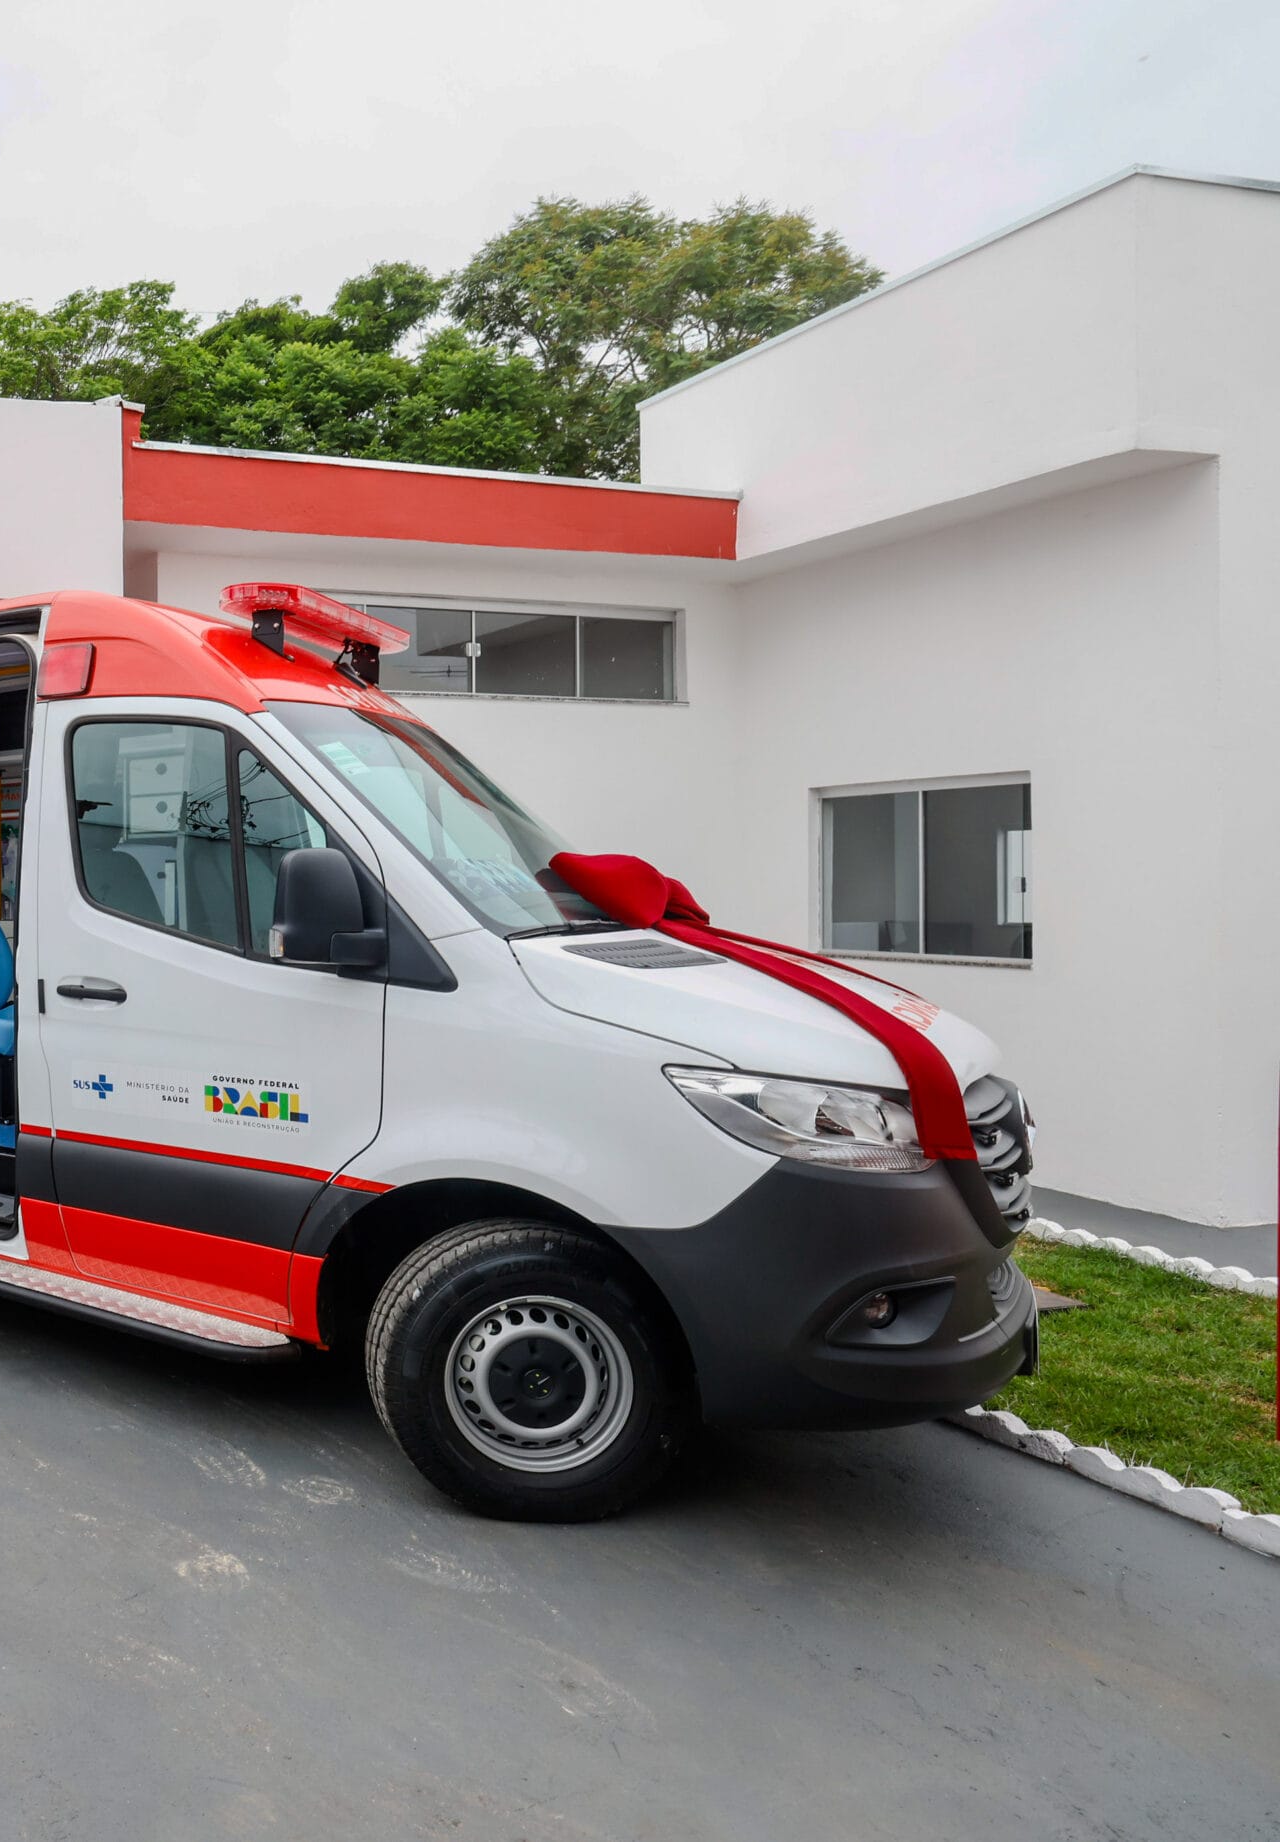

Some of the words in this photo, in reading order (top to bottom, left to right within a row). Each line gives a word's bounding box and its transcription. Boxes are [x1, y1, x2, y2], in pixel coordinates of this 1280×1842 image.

[73, 1080, 91, 1090] SUS
[212, 1075, 255, 1085] GOVERNO
[258, 1079, 300, 1090] FEDERAL
[162, 1094, 190, 1104] SAÚDE
[204, 1085, 309, 1123] BRASIL
